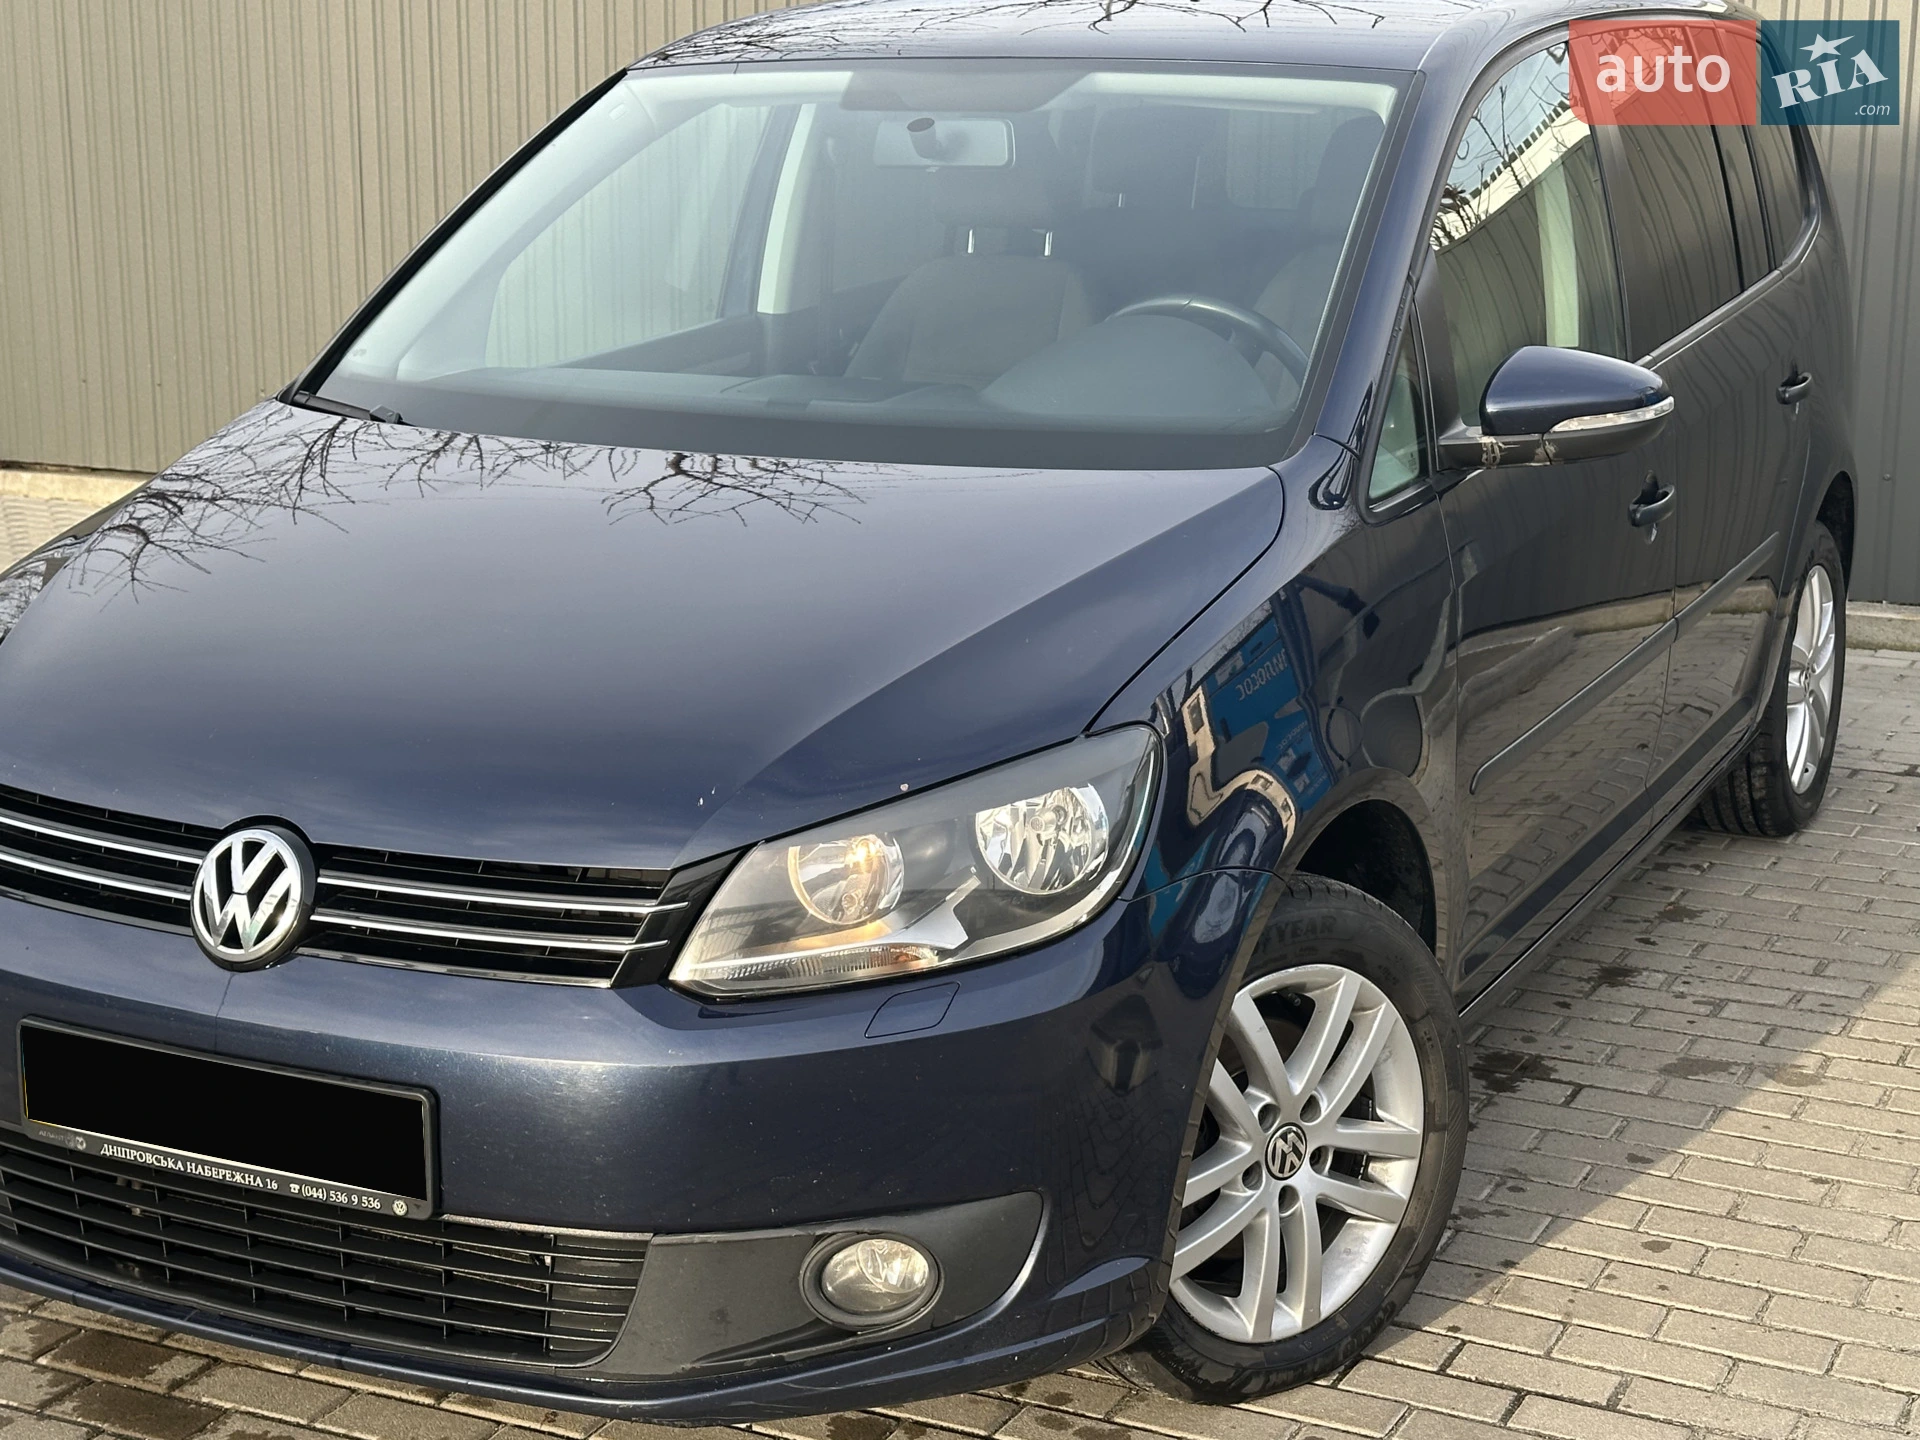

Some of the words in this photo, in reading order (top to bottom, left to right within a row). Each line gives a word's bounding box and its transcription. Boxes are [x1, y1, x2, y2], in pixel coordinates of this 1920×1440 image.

[100, 1143, 184, 1171] ДНІПРОВСЬКА
[186, 1162, 264, 1188] НАБЕРЕЖНА
[265, 1178, 278, 1190] 16
[301, 1184, 327, 1201] (044)
[329, 1190, 348, 1204] 536
[351, 1194, 359, 1206] 9
[361, 1196, 381, 1210] 536
